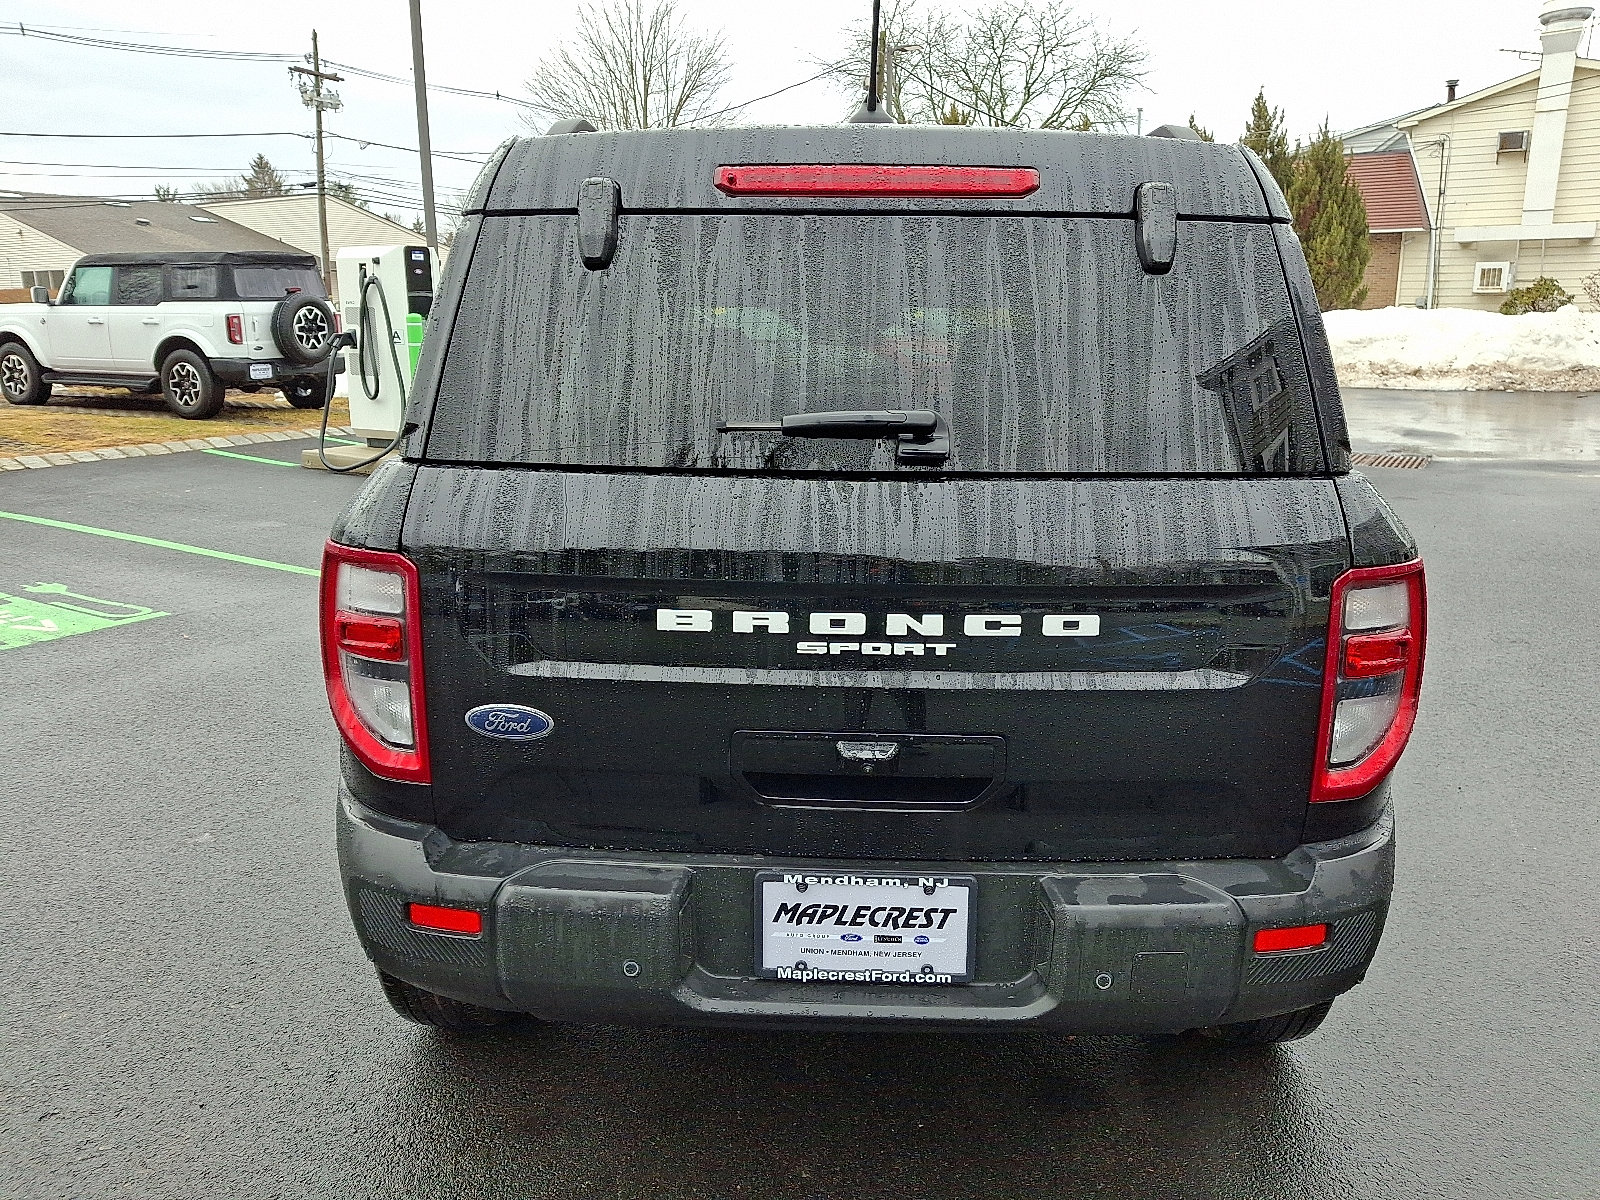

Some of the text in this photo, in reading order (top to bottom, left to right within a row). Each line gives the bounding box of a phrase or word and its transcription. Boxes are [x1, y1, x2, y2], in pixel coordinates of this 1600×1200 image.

[656, 608, 1101, 637] BRONCO
[796, 641, 957, 656] SPORT
[484, 711, 532, 732] Ford
[783, 874, 950, 889] Mendham, NJ
[772, 902, 958, 931] MAPLECREST
[800, 947, 825, 955] UNION
[830, 949, 872, 958] MENDHAM,
[874, 950, 891, 958] NEW
[777, 967, 952, 984] MaplecrestFord.com
